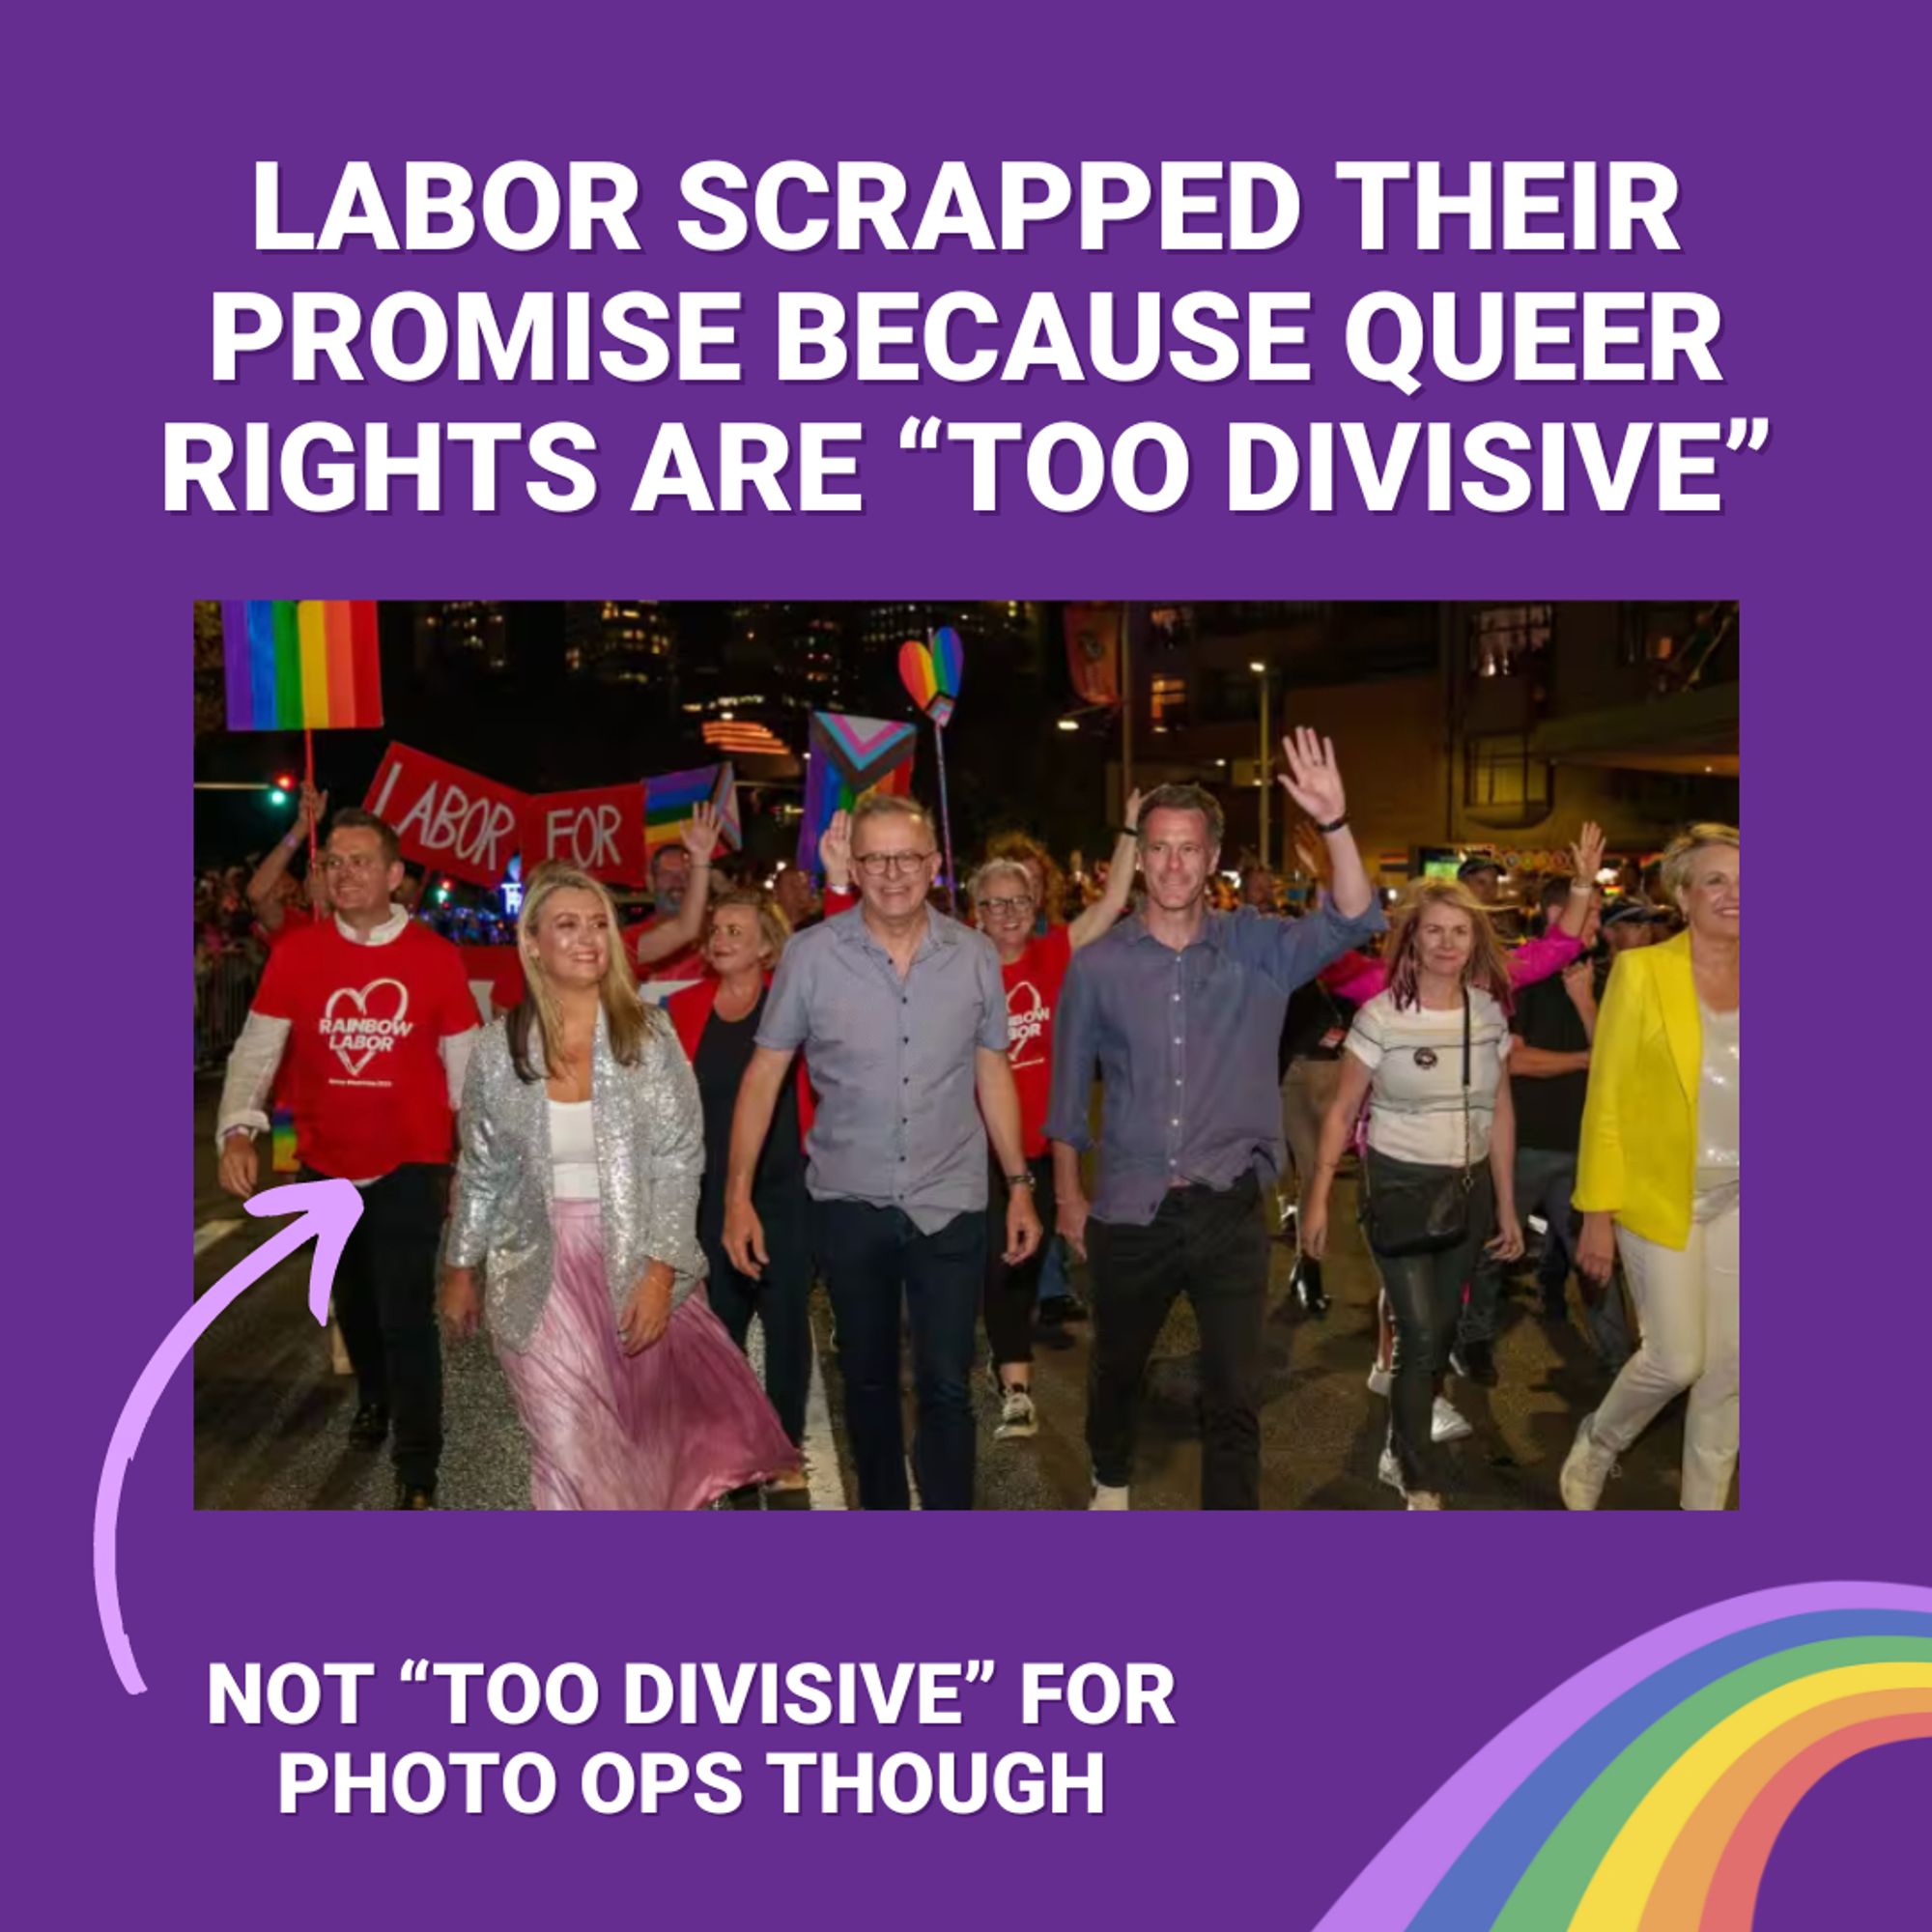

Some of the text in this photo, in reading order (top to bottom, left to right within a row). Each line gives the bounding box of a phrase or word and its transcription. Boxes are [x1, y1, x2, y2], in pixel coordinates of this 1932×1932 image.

[372, 761, 621, 870] LABOR FOR
[319, 1018, 412, 1037] RAINBOW
[328, 1035, 394, 1051] LABOR
